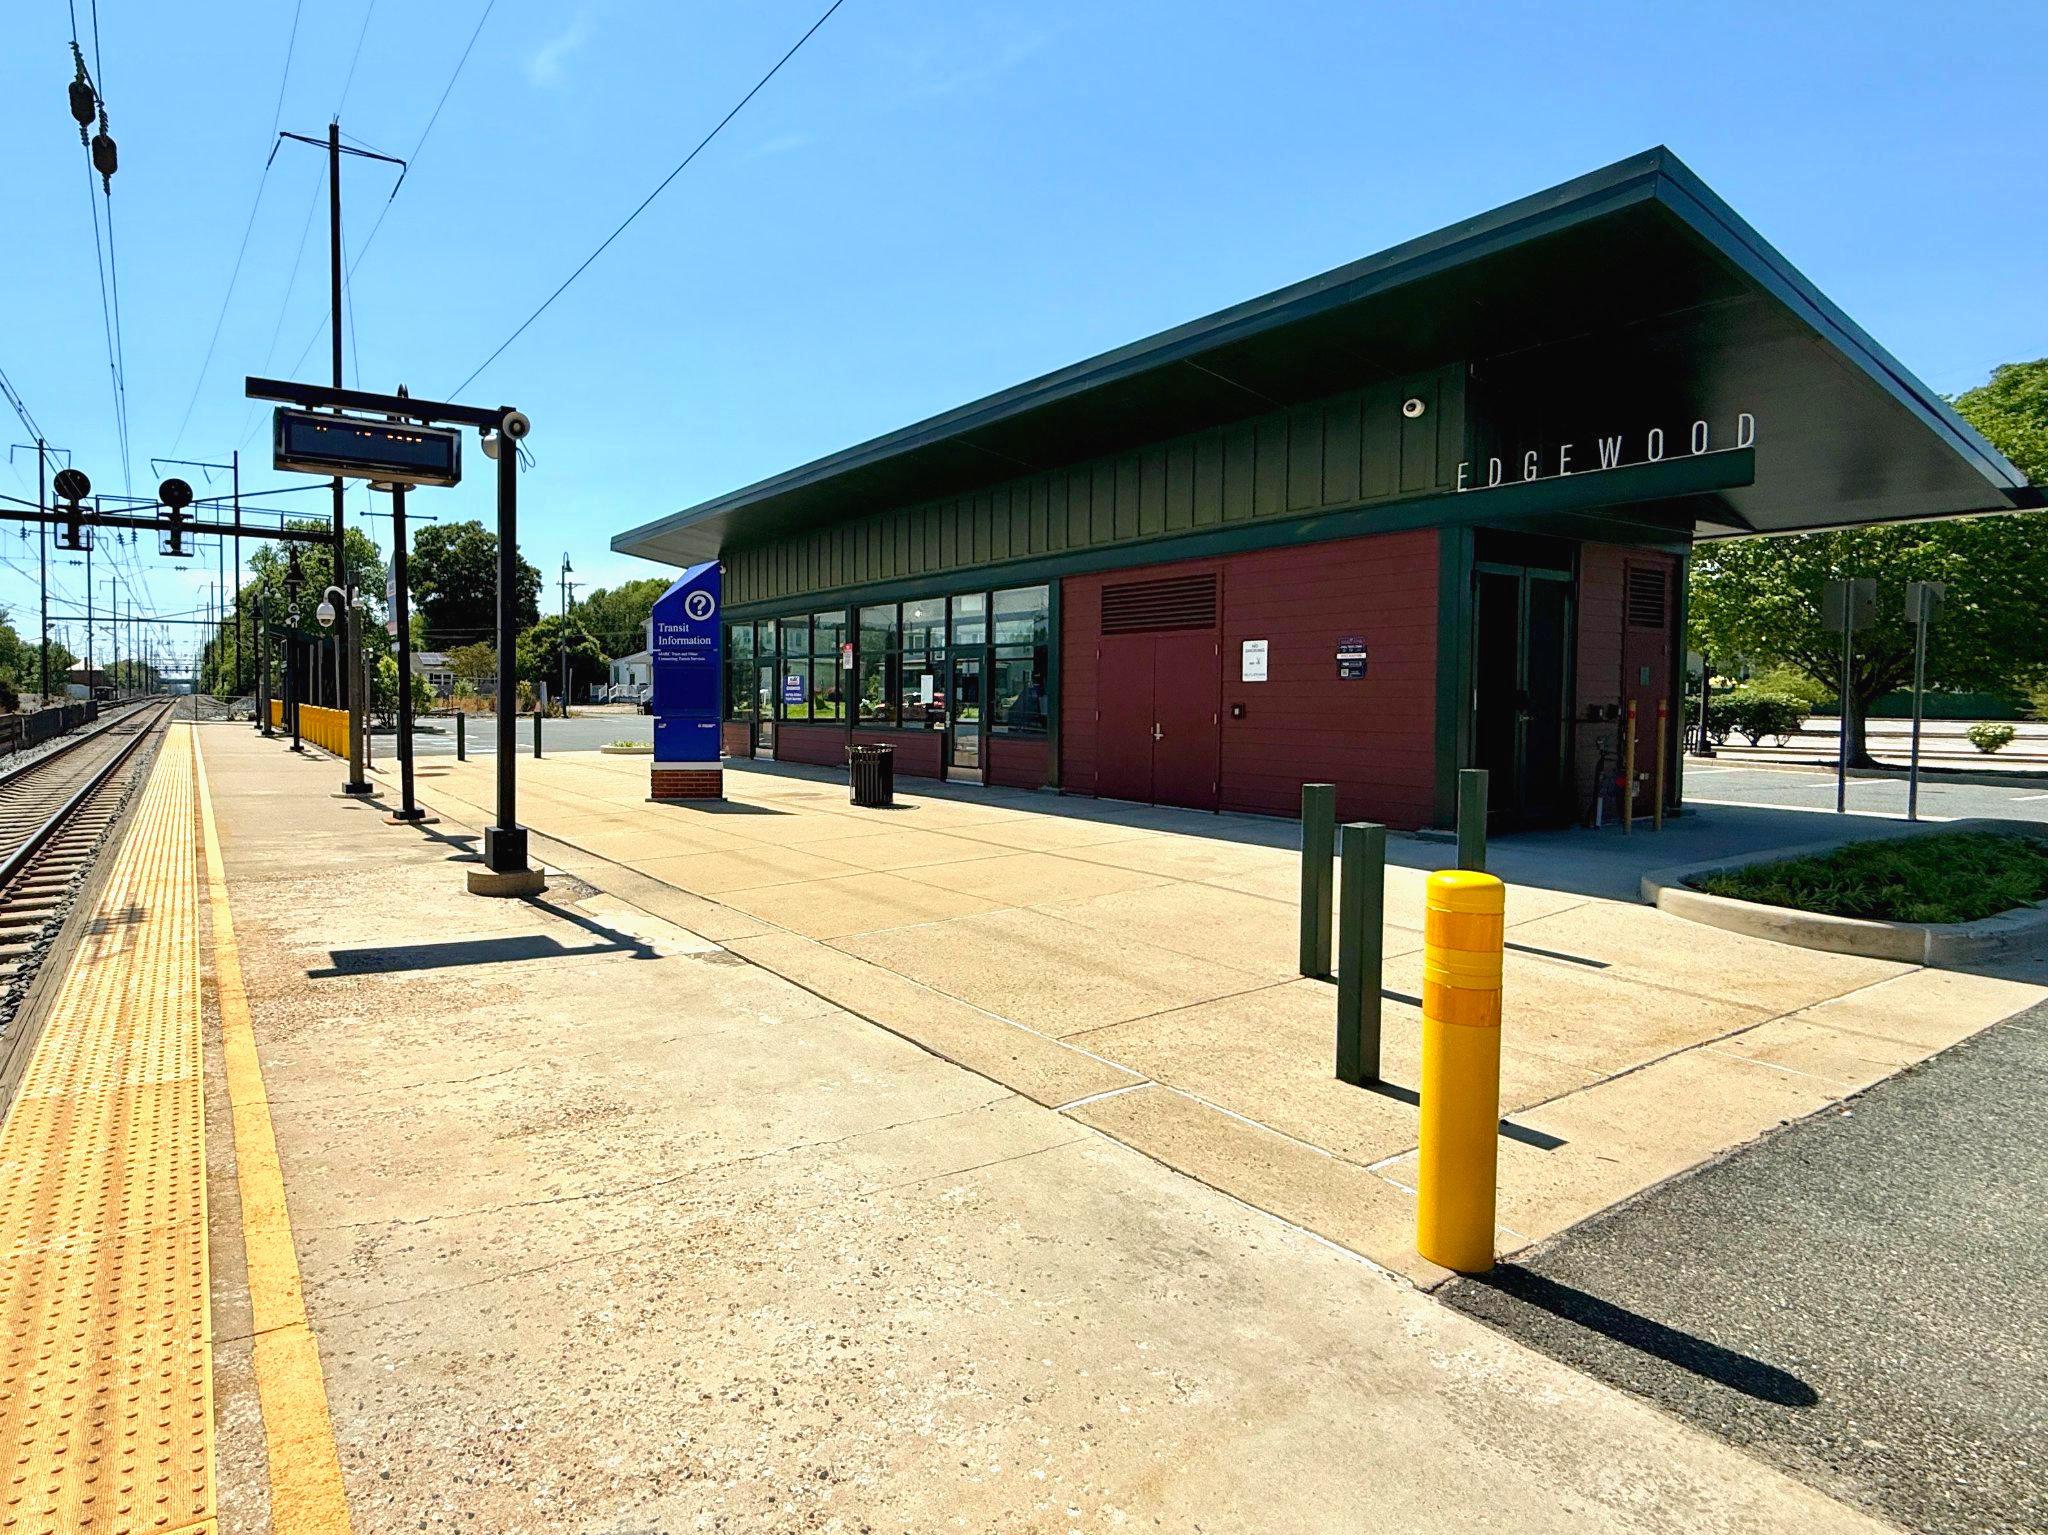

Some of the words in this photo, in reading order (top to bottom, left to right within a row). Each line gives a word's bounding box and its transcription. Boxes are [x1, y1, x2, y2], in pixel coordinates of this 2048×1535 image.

[1457, 413, 1755, 492] EDGEWOOD
[657, 622, 689, 633] Transit
[658, 635, 712, 645] Information
